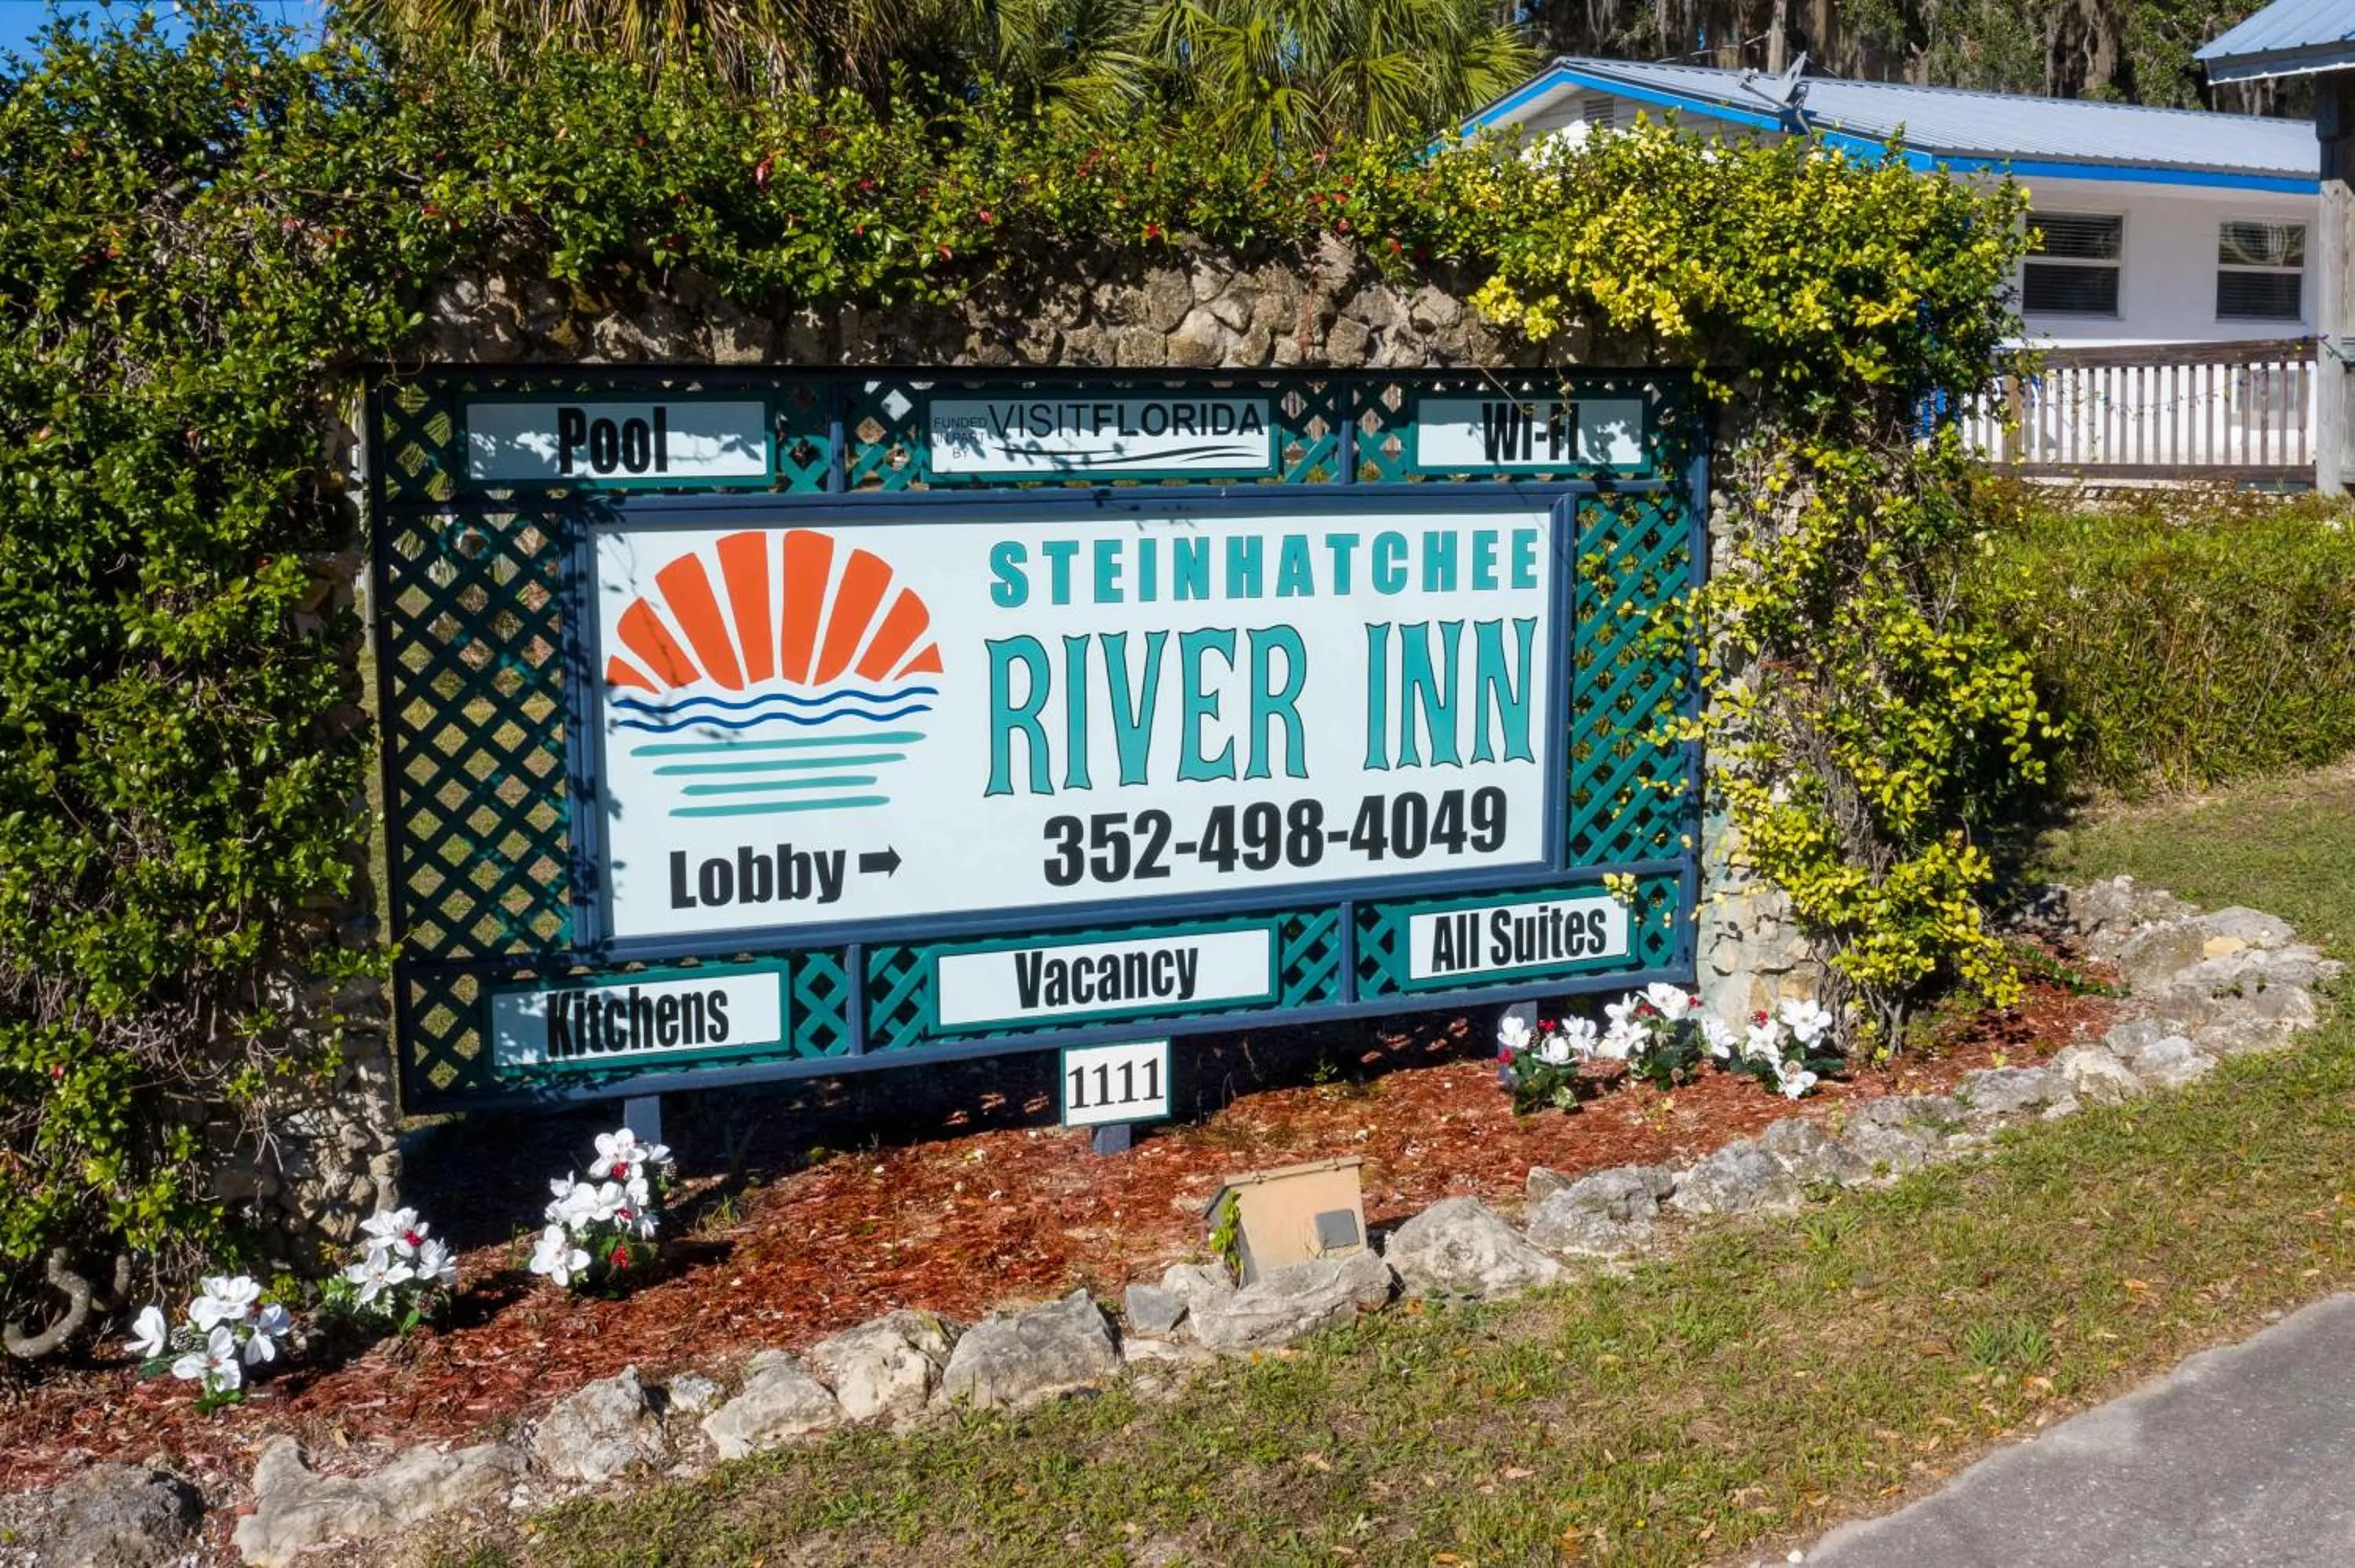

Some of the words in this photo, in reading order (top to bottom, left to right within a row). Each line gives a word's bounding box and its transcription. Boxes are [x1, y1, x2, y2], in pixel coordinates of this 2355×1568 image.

[558, 407, 668, 474] Pool
[933, 417, 988, 428] FUNDED
[952, 447, 969, 459] BY
[988, 403, 1265, 438] VISITFLORIDA
[989, 528, 1539, 608] STEINHATCHEE
[984, 624, 1310, 798] RIVER
[1364, 616, 1538, 772] INN
[1043, 786, 1507, 888] 352-498-4049
[670, 843, 847, 910] Lobby
[1431, 913, 1480, 973] All
[1489, 905, 1607, 966] Suites
[1014, 946, 1199, 1009] Vacancy
[546, 986, 729, 1058] Kitchens
[1067, 1057, 1165, 1110] 1111
